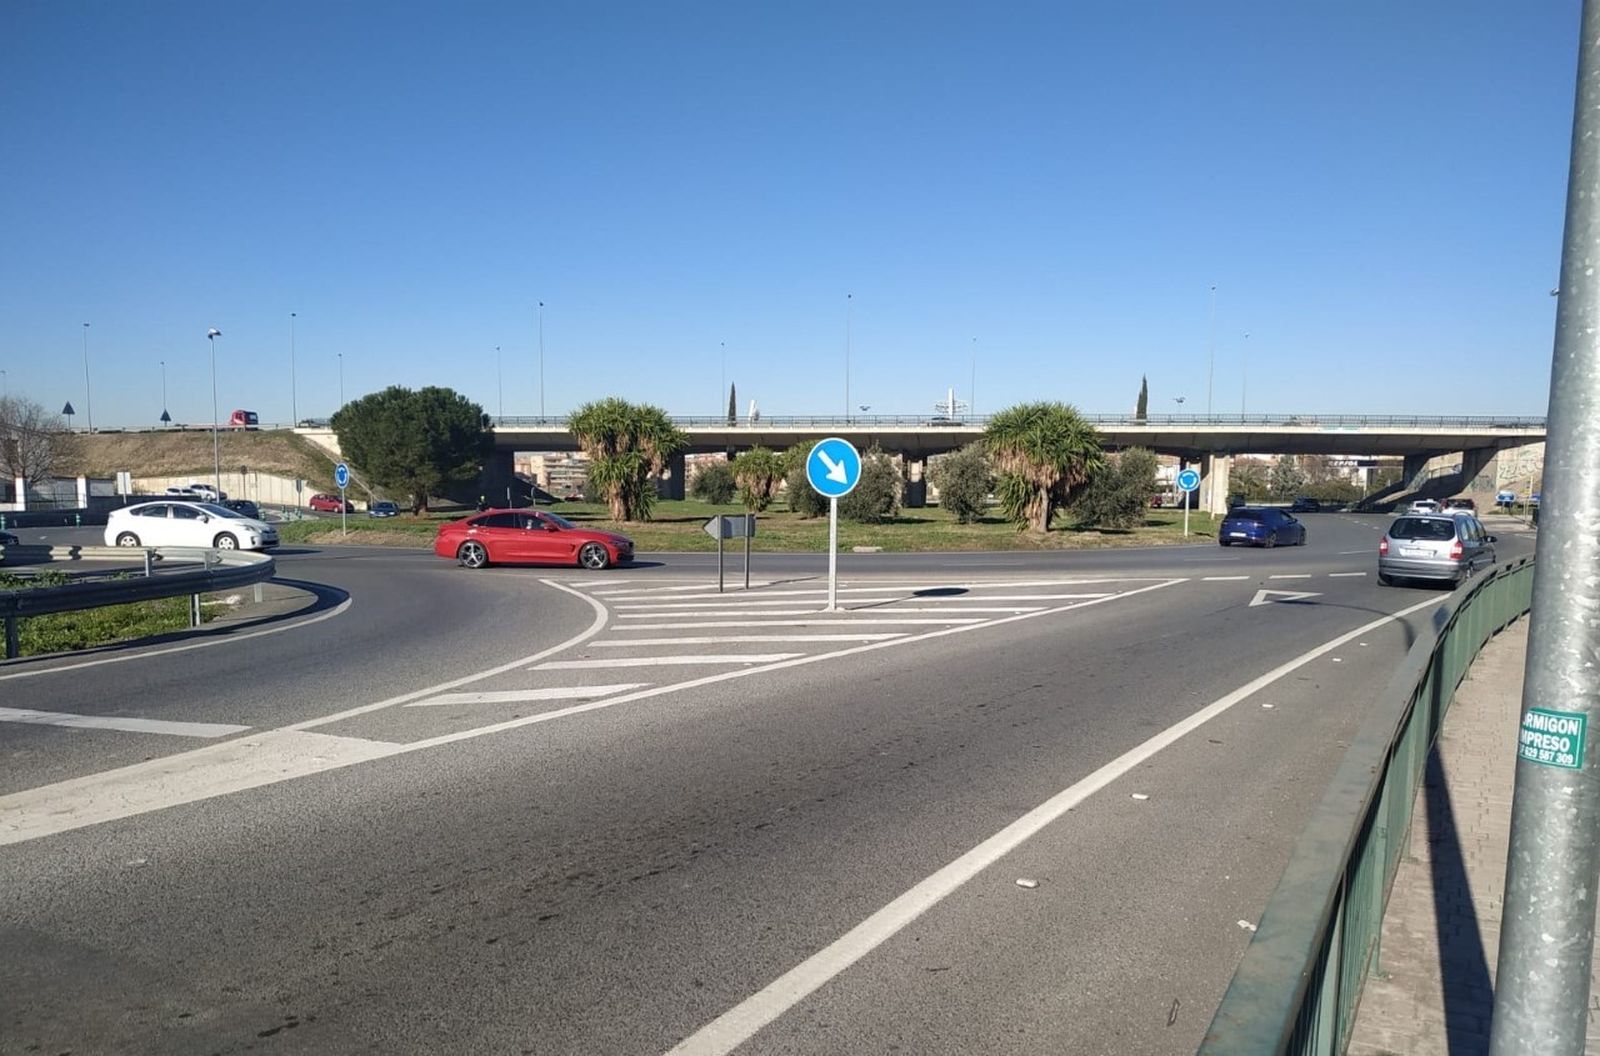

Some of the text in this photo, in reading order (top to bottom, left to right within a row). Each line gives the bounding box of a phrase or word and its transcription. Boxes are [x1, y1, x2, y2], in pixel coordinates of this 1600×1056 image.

[1523, 713, 1578, 736] RMIGON
[1539, 750, 1555, 761] 587
[1556, 753, 1573, 764] 309
